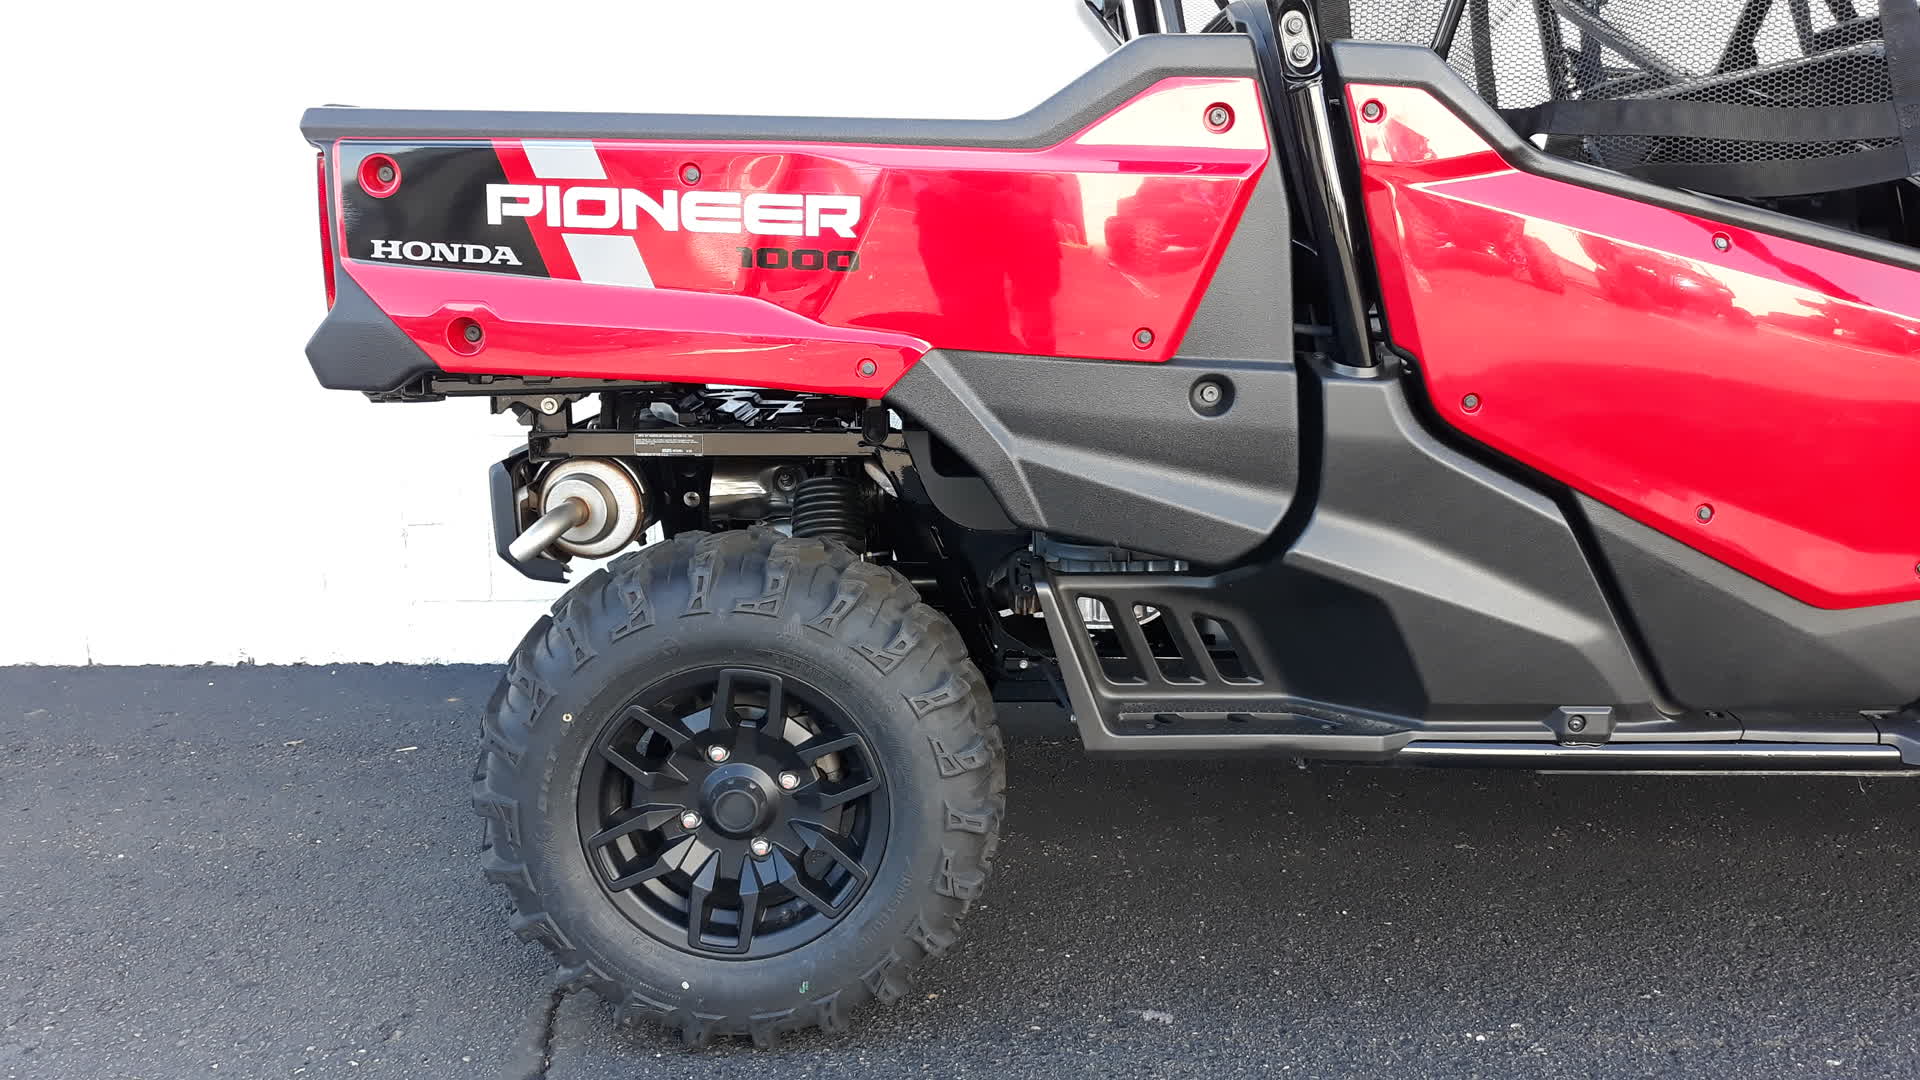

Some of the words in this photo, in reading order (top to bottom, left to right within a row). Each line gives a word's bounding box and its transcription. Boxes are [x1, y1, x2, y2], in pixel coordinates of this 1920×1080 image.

[486, 184, 861, 238] PIONEER
[370, 239, 523, 266] HONDA
[736, 246, 860, 272] 1000
